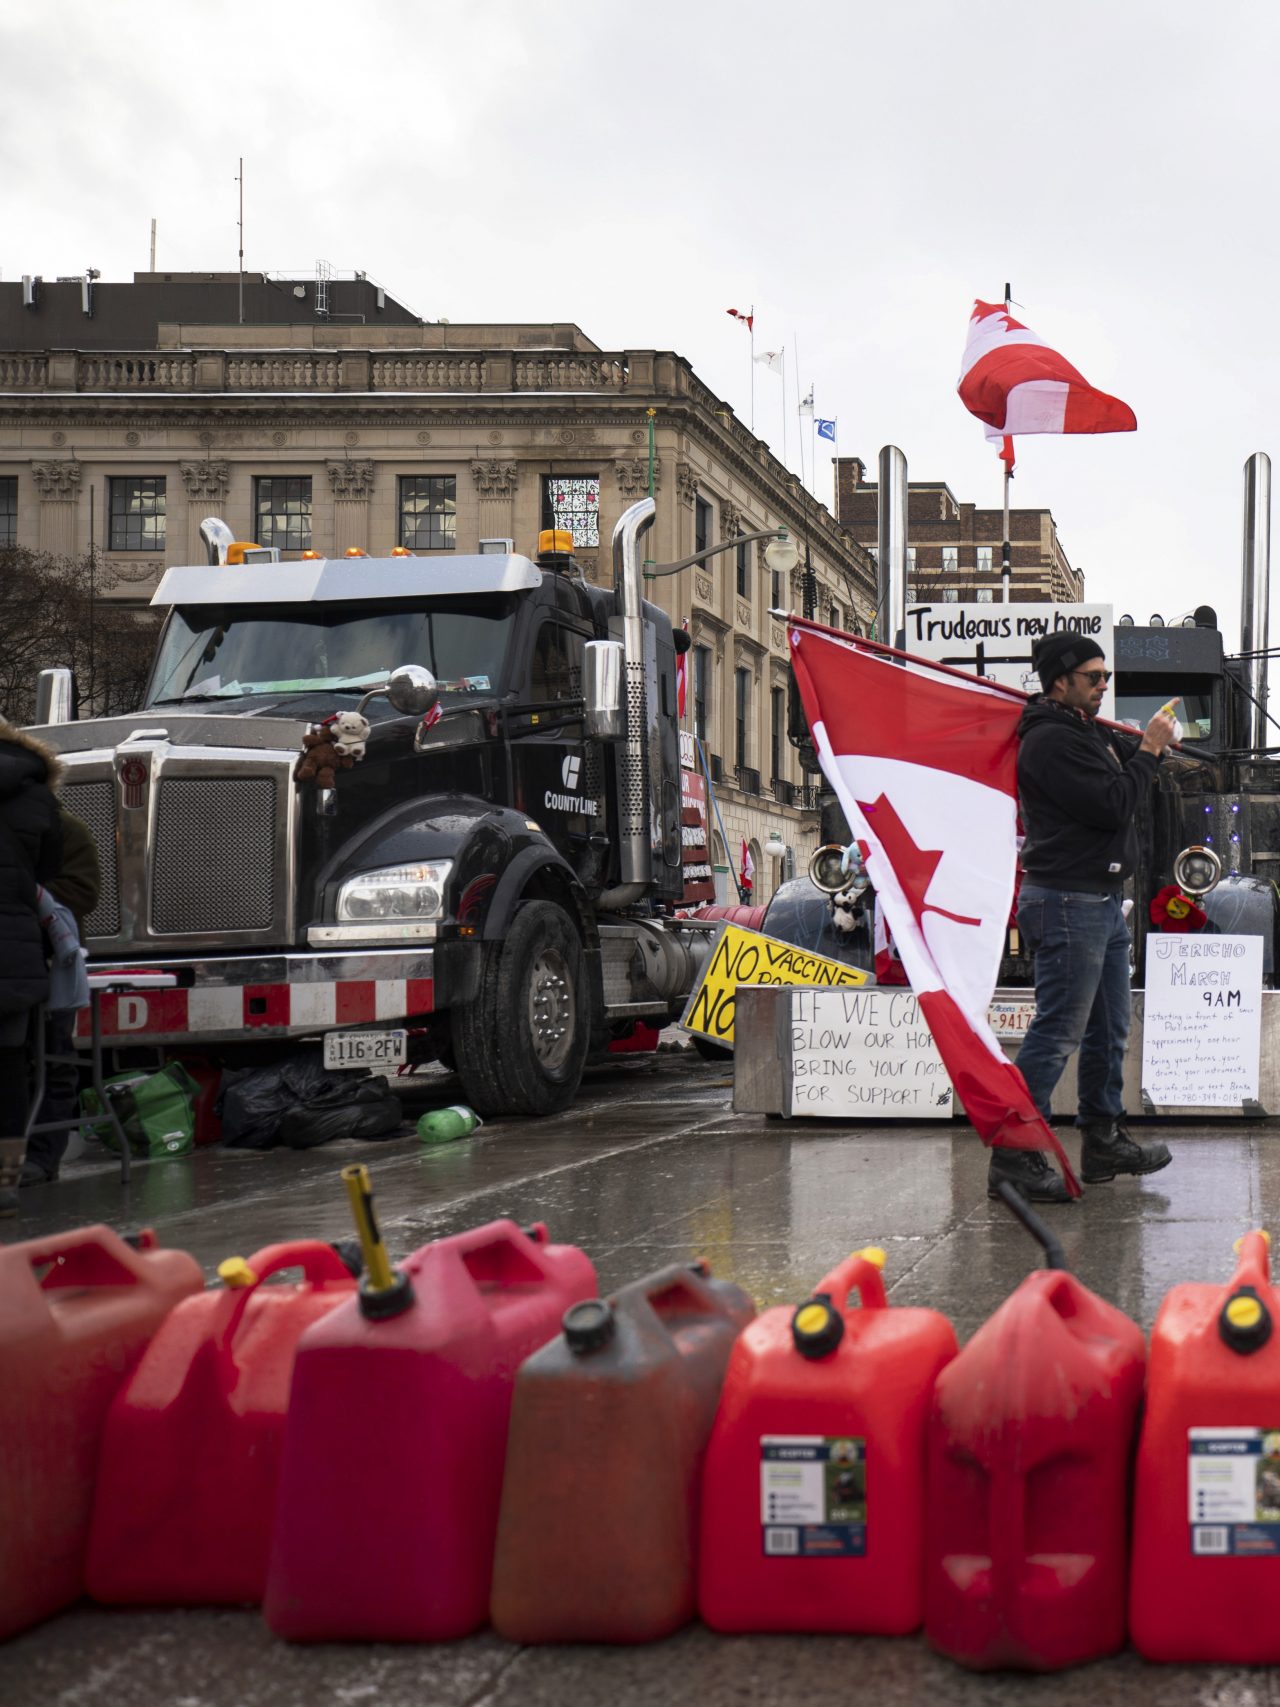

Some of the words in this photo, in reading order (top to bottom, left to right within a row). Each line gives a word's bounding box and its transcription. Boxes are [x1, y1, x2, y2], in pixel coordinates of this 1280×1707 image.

[907, 607, 1011, 641] Trudeau's
[1017, 615, 1049, 636] new
[1054, 611, 1102, 635] home
[711, 935, 759, 981] NO
[1156, 937, 1246, 959] JERICHO
[1171, 962, 1231, 986] MARCH
[792, 991, 825, 1023] IF
[842, 992, 878, 1026] WE
[792, 1028, 851, 1051] BLOW
[864, 1032, 894, 1049] OUR
[794, 1059, 857, 1077] BRING
[795, 1084, 833, 1104] FOR
